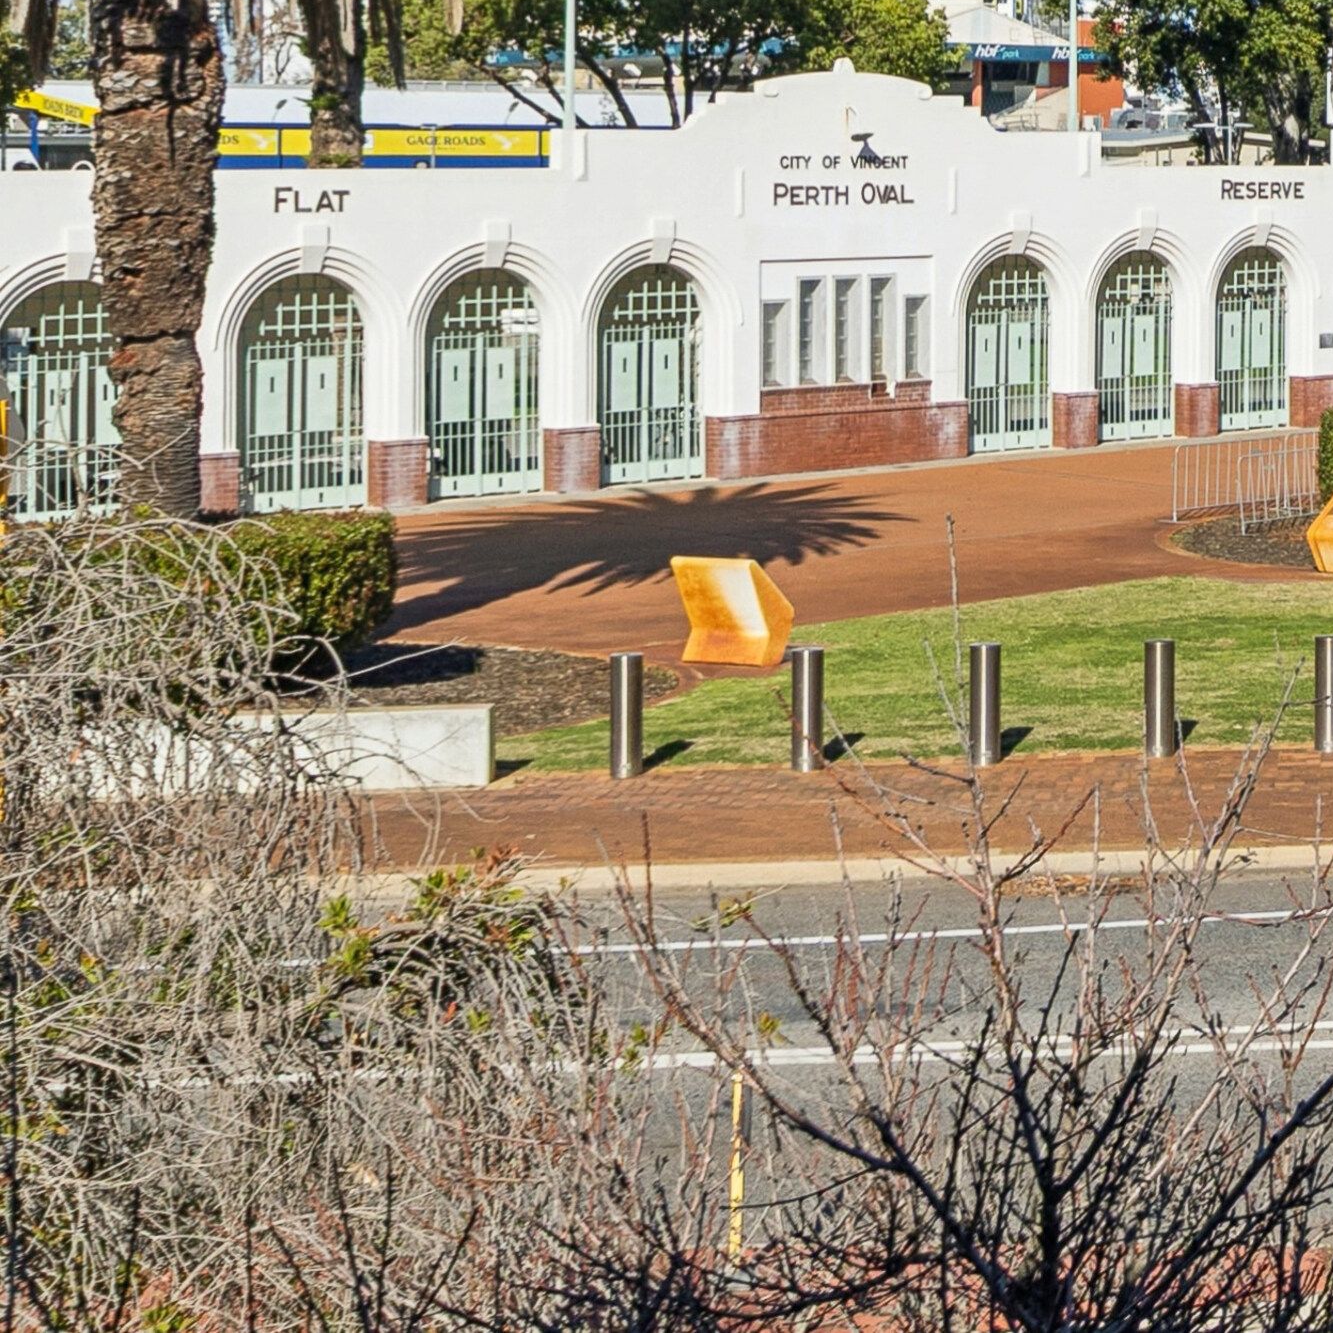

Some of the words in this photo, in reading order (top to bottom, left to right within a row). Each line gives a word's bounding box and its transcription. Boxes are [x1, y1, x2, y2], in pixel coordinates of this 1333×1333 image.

[975, 45, 999, 58] hbf
[1051, 47, 1073, 60] hb
[406, 136, 441, 146] GAGE
[444, 136, 486, 146] ROADS
[779, 155, 811, 169] CITY
[822, 155, 841, 169] OF
[850, 155, 908, 169] VINCENT
[773, 182, 849, 206] PERTH
[861, 182, 915, 205] OVAL
[1221, 179, 1304, 200] RESERVE
[274, 186, 350, 213] FLAT
